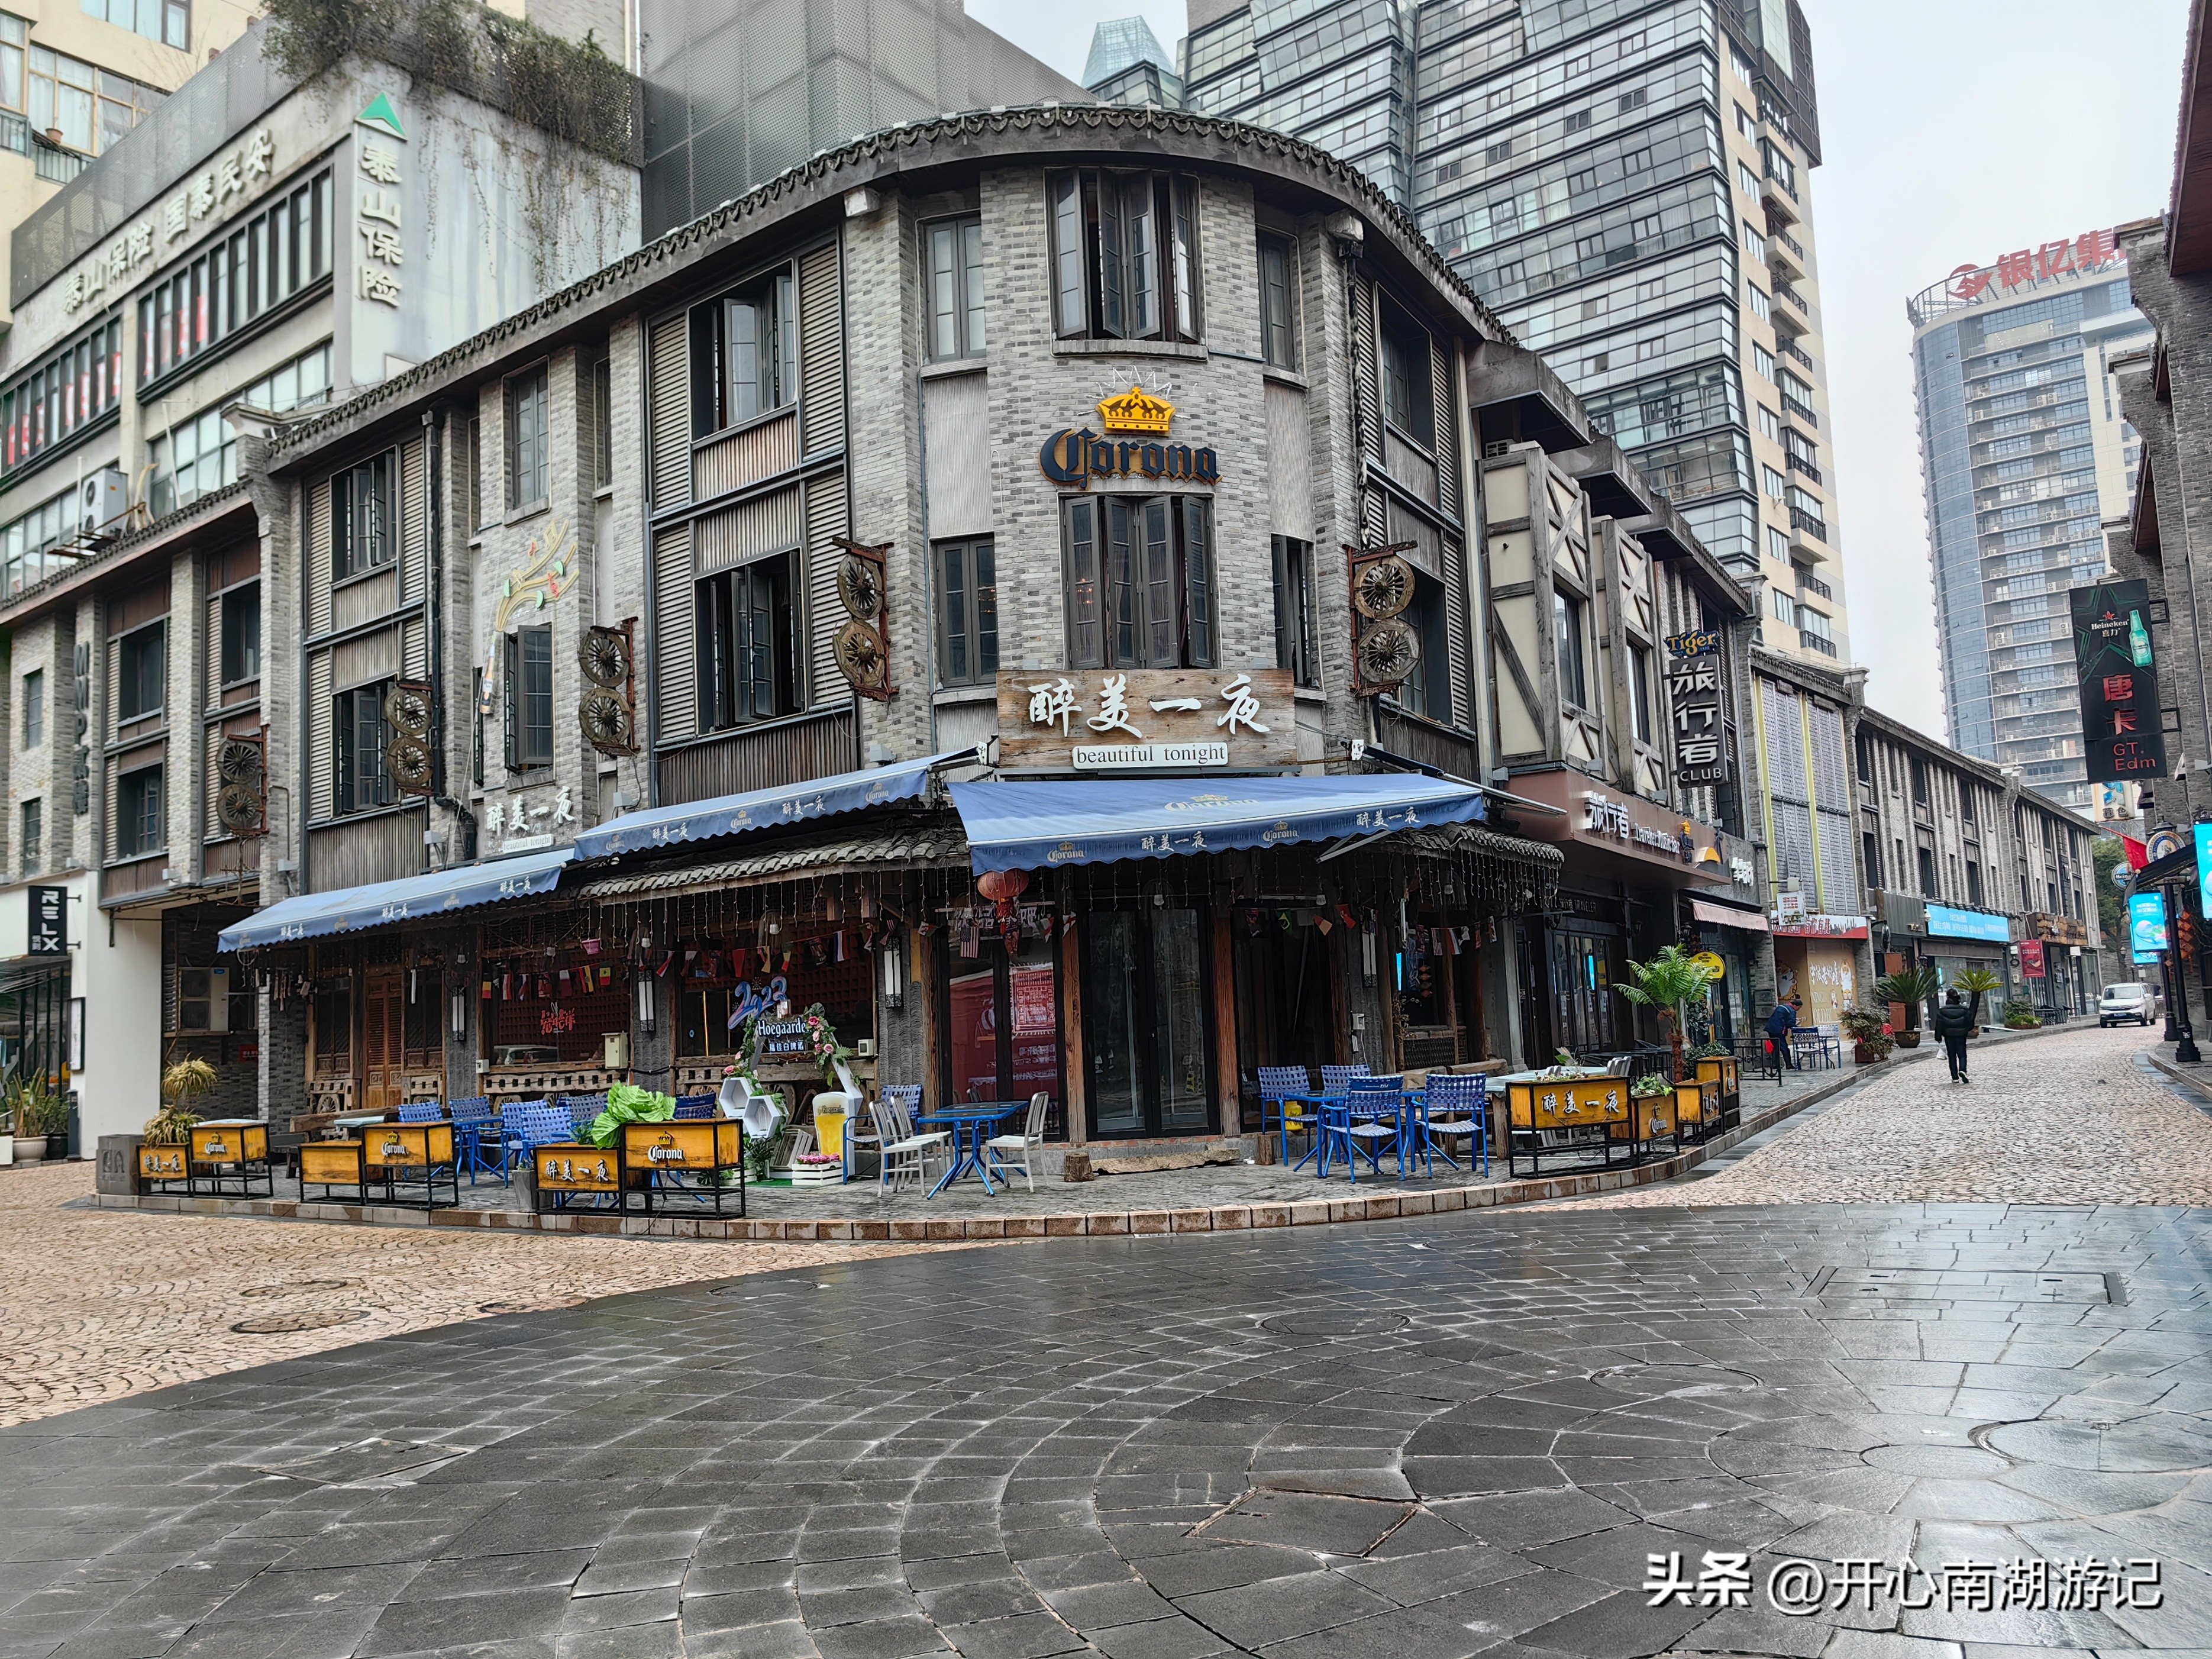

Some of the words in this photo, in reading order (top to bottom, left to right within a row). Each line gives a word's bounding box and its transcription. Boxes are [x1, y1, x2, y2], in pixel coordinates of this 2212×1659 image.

[64, 221, 153, 314] 泰山保险
[164, 128, 276, 243] 国泰民安
[360, 144, 403, 308] 泰山保险
[1996, 228, 2126, 288] 银亿集
[1039, 427, 1222, 489] Corona
[2091, 619, 2129, 631] Heineken
[1667, 631, 1717, 656] Tiger
[1027, 673, 1270, 738] 醉美一夜
[1672, 661, 1719, 764] 旅行者
[2103, 674, 2136, 735] 唐卡
[1076, 746, 1154, 764] beautiful
[1164, 745, 1226, 764] tonight
[2113, 742, 2145, 757] GT.
[1680, 767, 1722, 782] CLUB
[2114, 757, 2156, 772] Edm
[782, 795, 826, 816] 醉美一夜
[865, 789, 890, 805] Corona
[486, 786, 576, 837] 醉美一夜
[1356, 806, 1422, 827] 醉美一夜
[1584, 790, 1629, 839] 旅行者
[653, 822, 689, 841] 醉美一夜
[731, 818, 753, 830] Corona
[503, 839, 528, 850] beautiful
[530, 835, 551, 847] tonight
[1141, 831, 1209, 852] 醉美一夜
[1262, 828, 1300, 843] Corona
[1047, 849, 1086, 863] Corona
[41, 890, 60, 951] RELX
[757, 1016, 812, 1038] Hoegaarde
[1541, 1089, 1620, 1115] 醉美一夜
[381, 1142, 408, 1156] Corona
[647, 1144, 684, 1163] Corona
[544, 1158, 609, 1183] 醉美一夜
